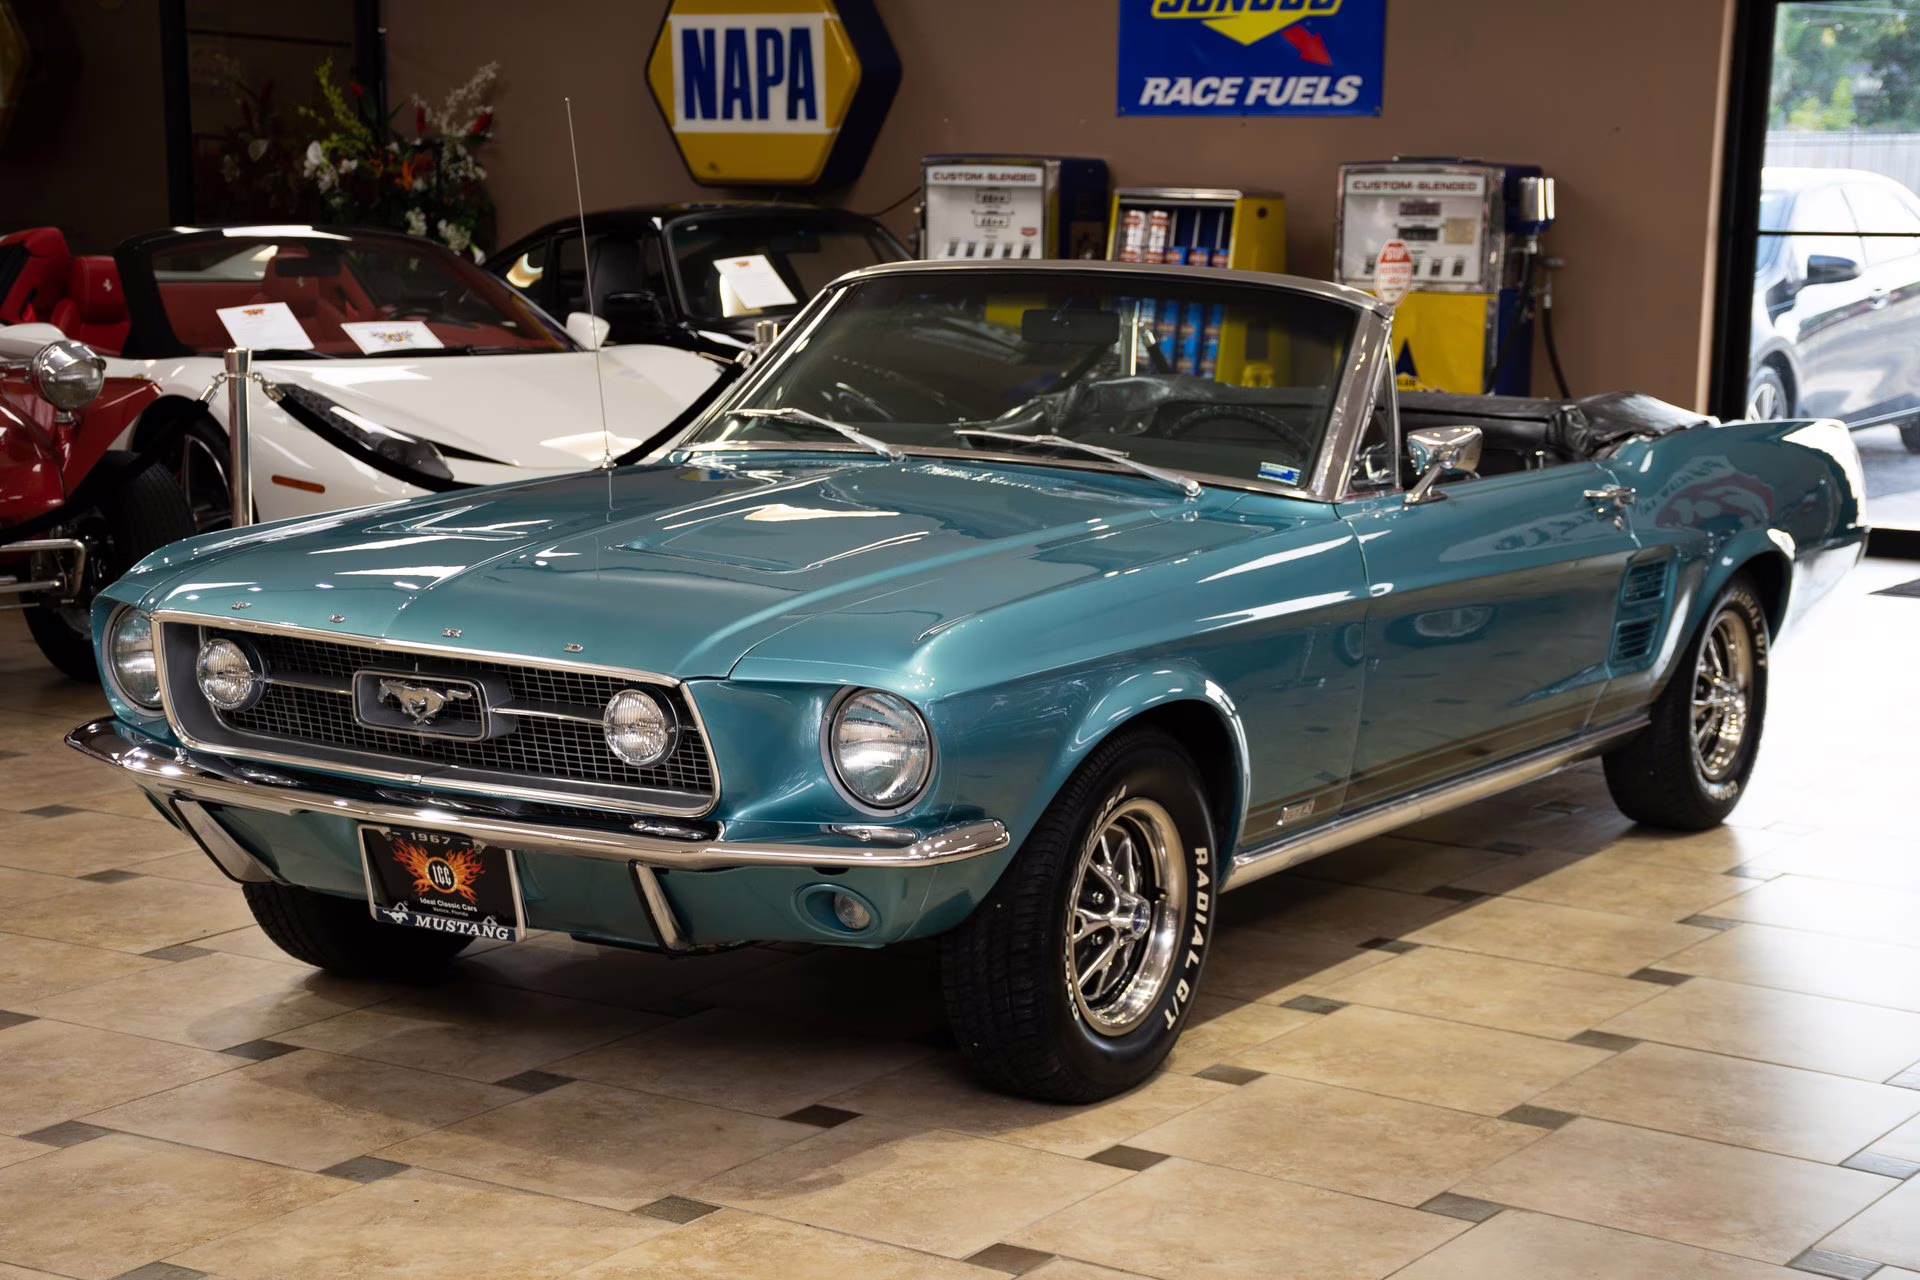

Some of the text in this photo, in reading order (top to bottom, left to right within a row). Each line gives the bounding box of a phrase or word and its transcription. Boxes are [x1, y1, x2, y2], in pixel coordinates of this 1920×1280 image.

[682, 28, 817, 121] NAPA
[1139, 75, 1363, 106] RACE FUELS
[933, 172, 1037, 182] CUSTOM BLENDED
[1352, 180, 1477, 192] CUSTOM BLENDED
[410, 831, 451, 845] 1967
[432, 863, 452, 887] ICC
[419, 897, 478, 912] Ideal Classic Cars
[414, 914, 509, 940] MUSTANG
[1164, 847, 1210, 1031] RADIAL G/T
